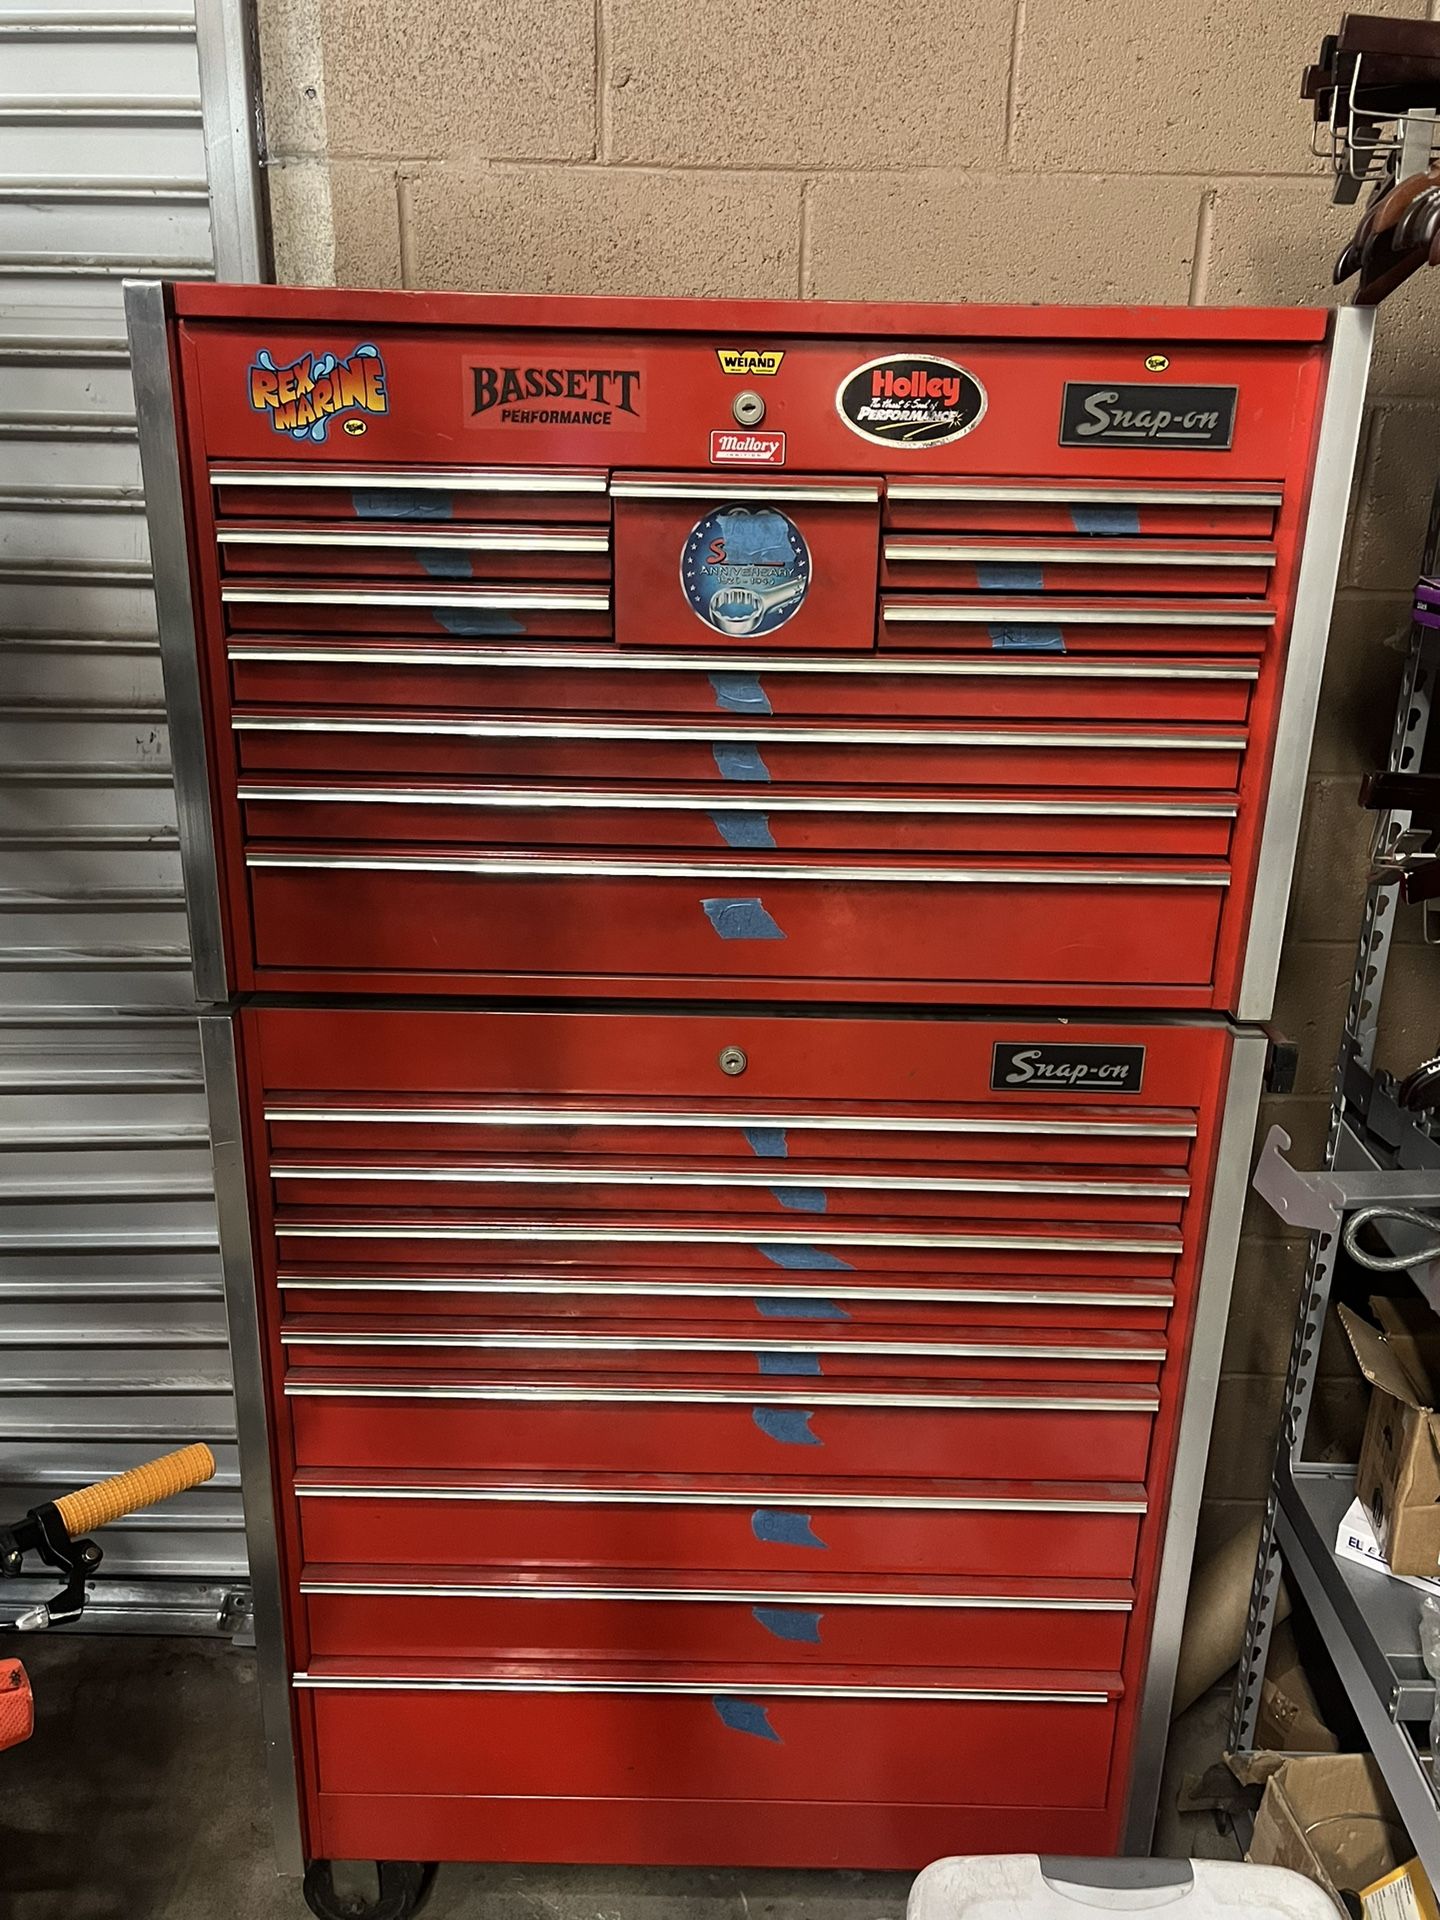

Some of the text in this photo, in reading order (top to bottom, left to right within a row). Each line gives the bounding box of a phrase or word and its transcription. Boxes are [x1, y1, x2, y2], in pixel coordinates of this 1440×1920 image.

[724, 356, 776, 368] WEIAND
[251, 353, 315, 409] REX
[273, 355, 386, 430] MARINE
[470, 366, 640, 417] BASSETT
[871, 369, 961, 407] Holley
[501, 408, 612, 425] PERFORMANCE
[857, 405, 958, 421] PERFORMANCE
[1075, 391, 1220, 437] Snap-on
[718, 435, 780, 460] Mallory
[1005, 1050, 1130, 1084] Snap-on
